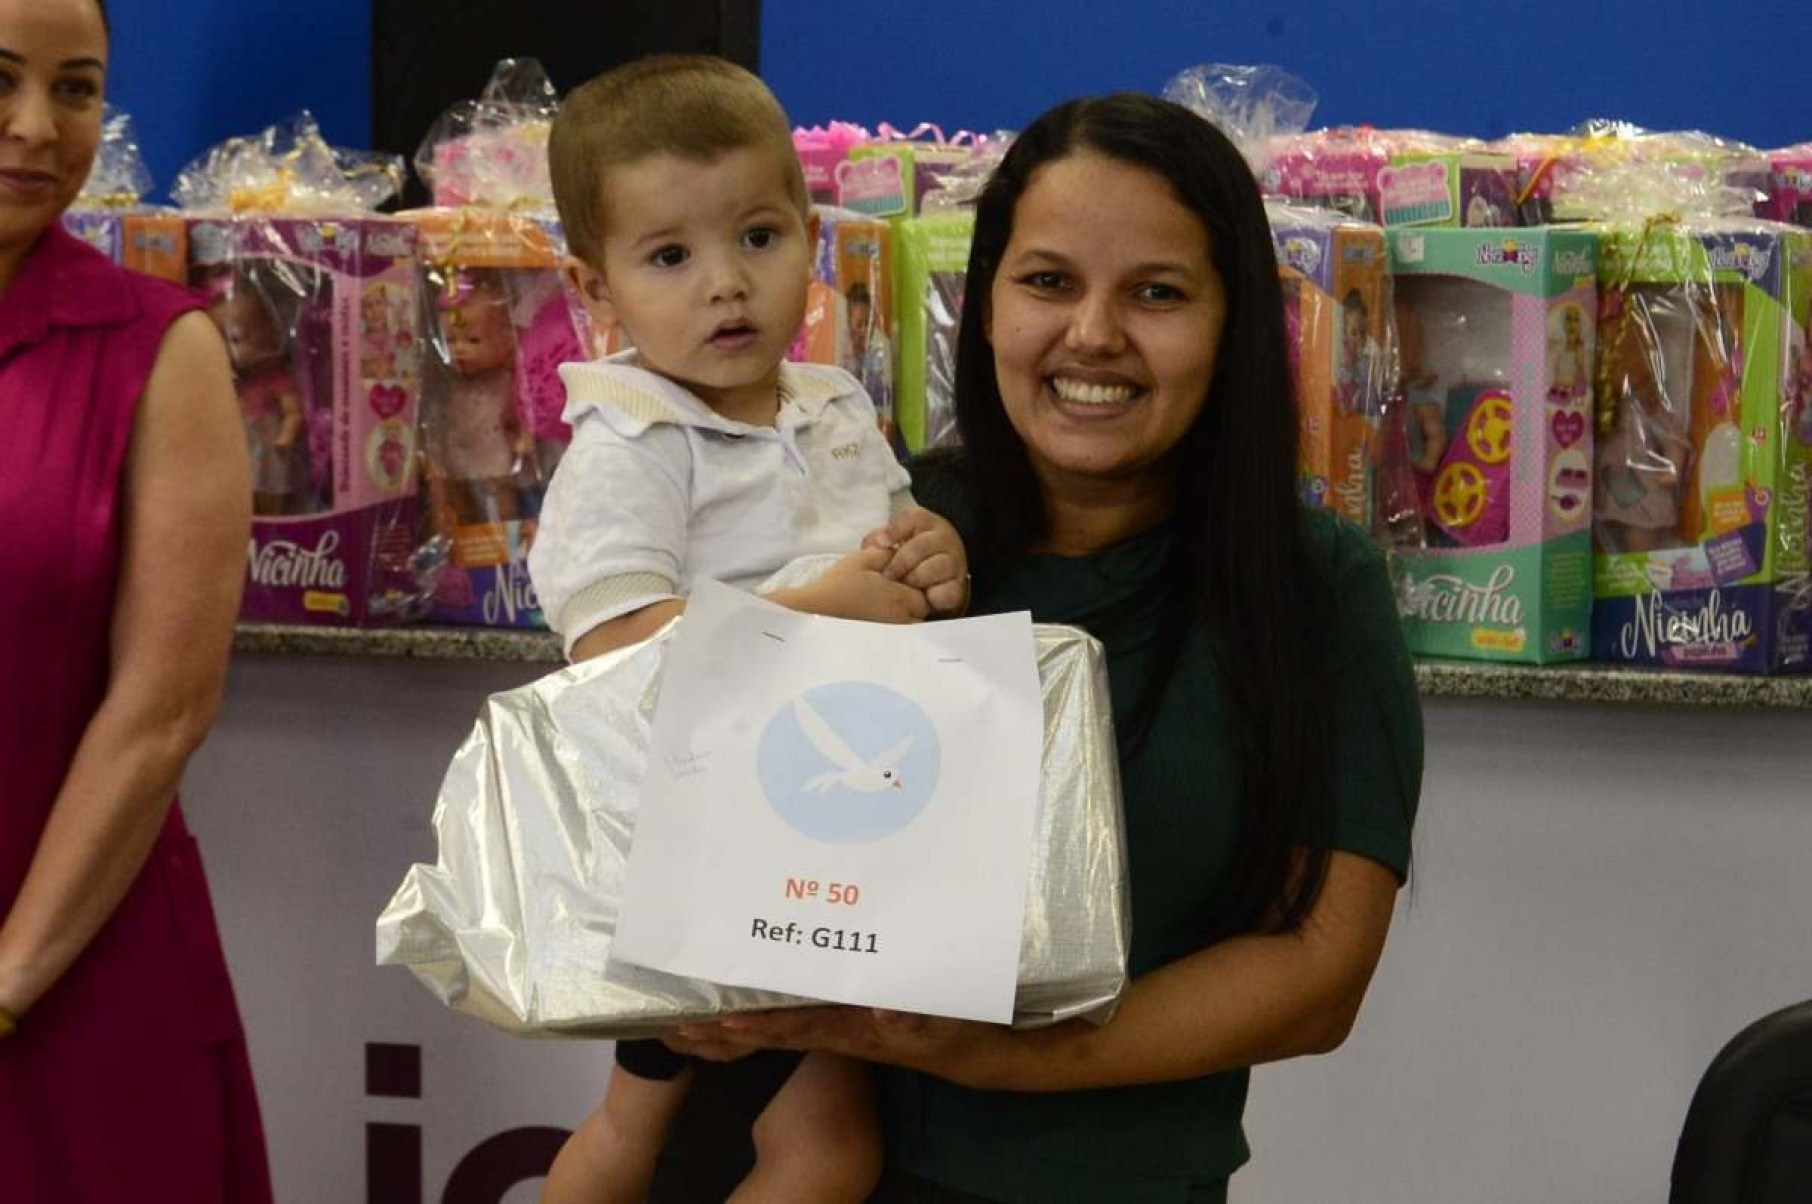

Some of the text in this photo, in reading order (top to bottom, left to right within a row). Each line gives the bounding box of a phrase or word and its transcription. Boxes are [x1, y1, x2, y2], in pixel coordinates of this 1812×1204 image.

[248, 530, 345, 588] Nicinha
[785, 877, 860, 906] Nº 50
[751, 918, 879, 953] Ref: G111
